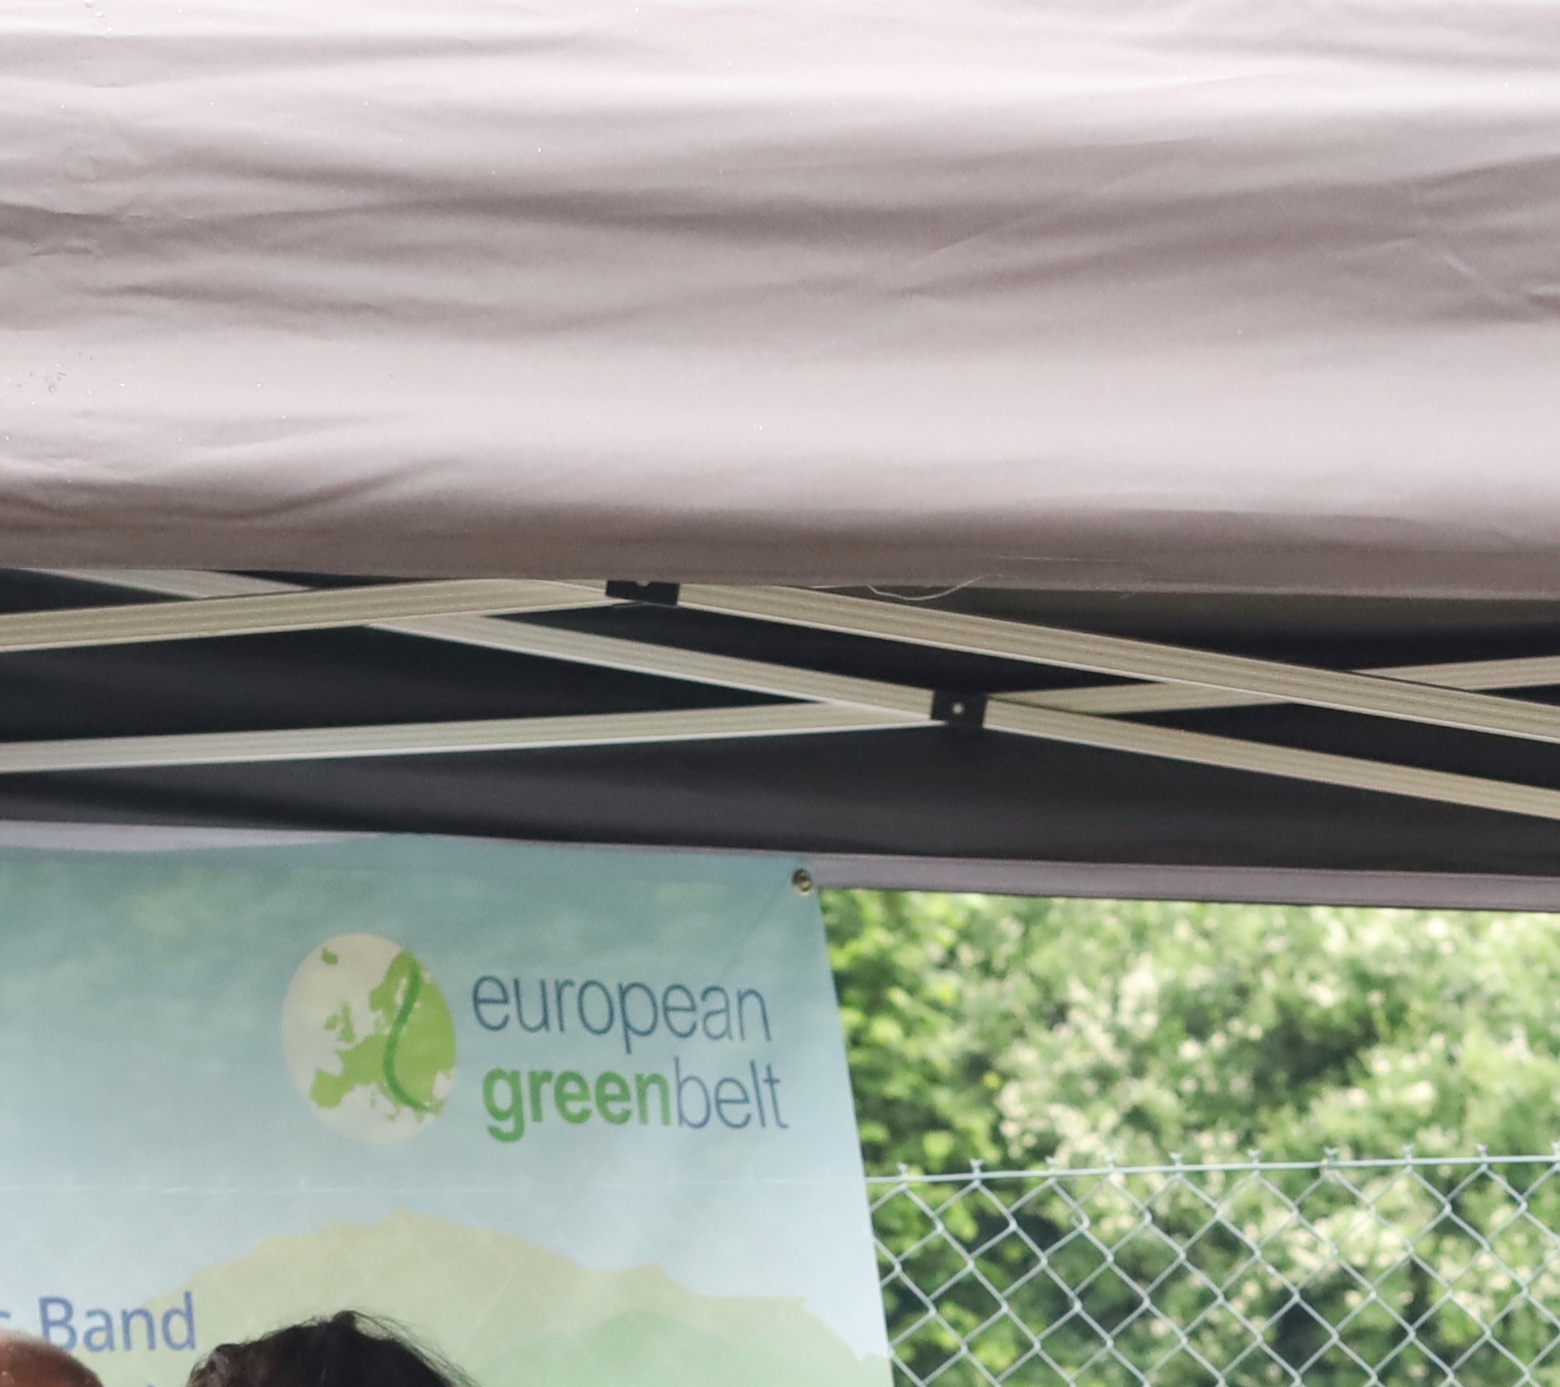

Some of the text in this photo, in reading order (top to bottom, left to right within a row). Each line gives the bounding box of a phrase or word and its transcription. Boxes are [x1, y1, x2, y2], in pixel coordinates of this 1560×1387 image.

[473, 972, 771, 1054] european
[483, 1056, 789, 1142] greenbelt
[39, 1291, 197, 1352] Band
